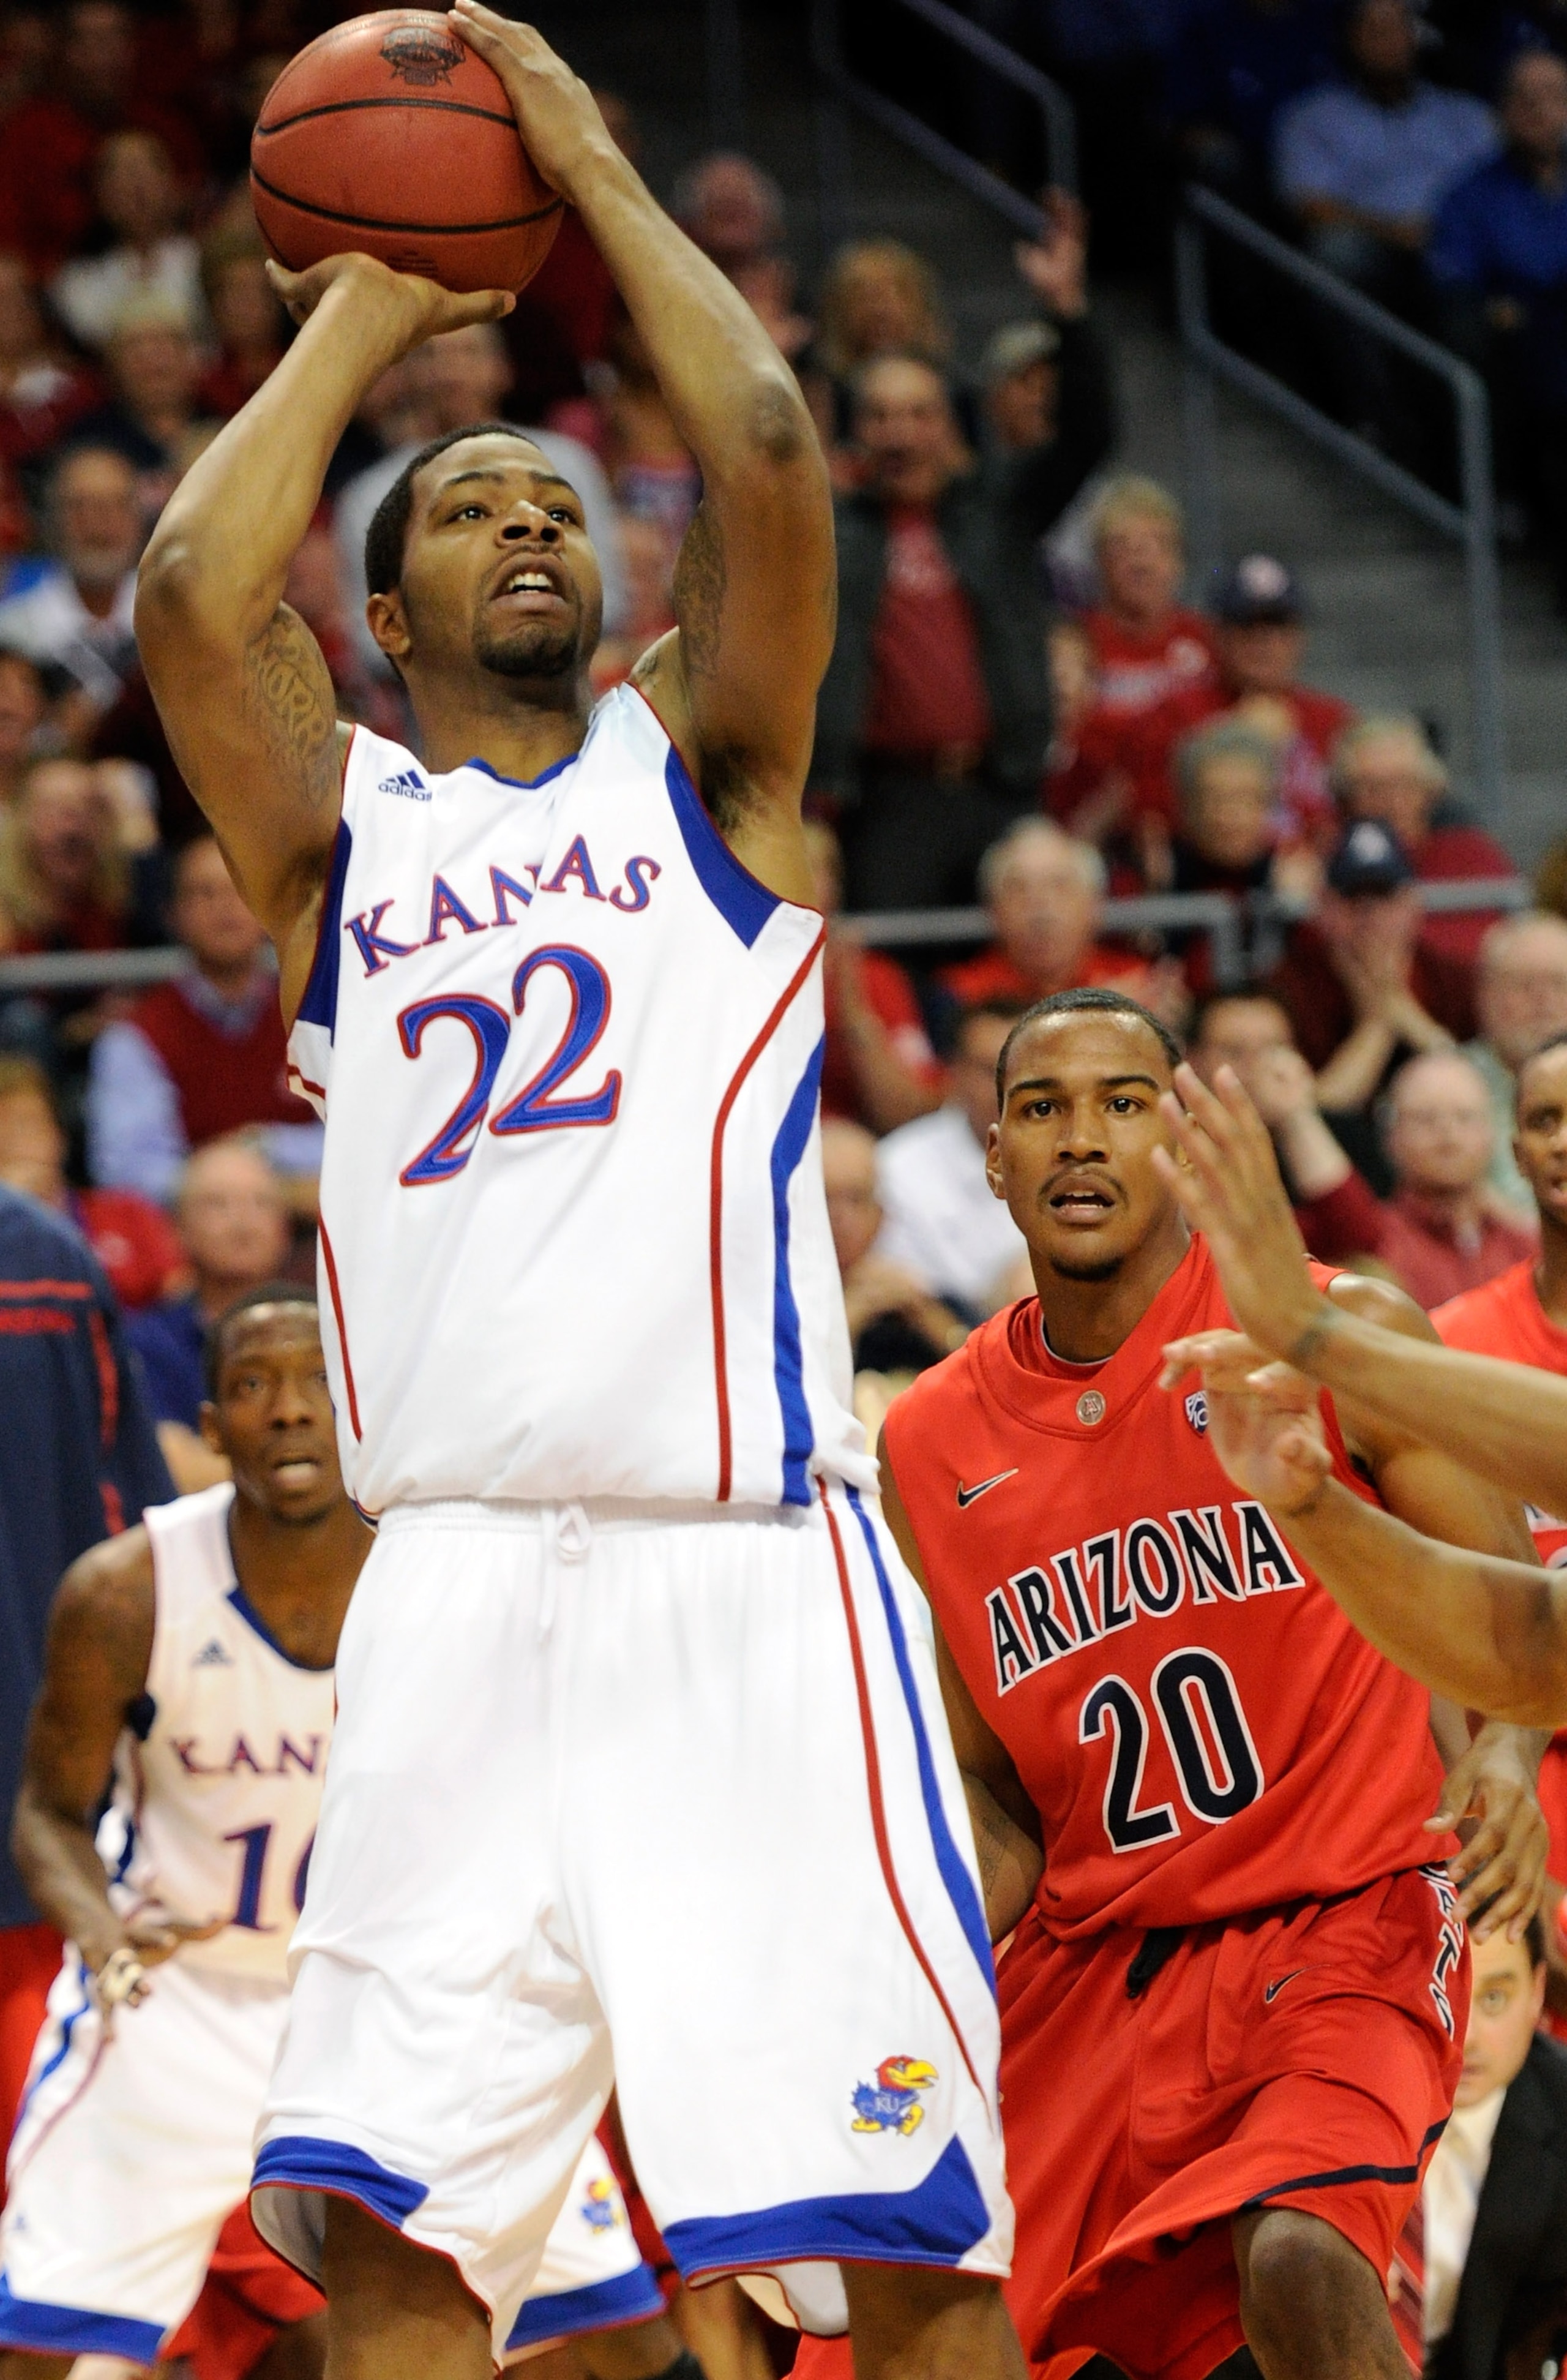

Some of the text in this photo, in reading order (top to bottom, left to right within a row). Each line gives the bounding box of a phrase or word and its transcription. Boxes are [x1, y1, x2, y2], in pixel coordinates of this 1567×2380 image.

[397, 942, 623, 1188] 22
[985, 1500, 1306, 1698] ARIZONA
[1078, 1645, 1265, 1855] 20
